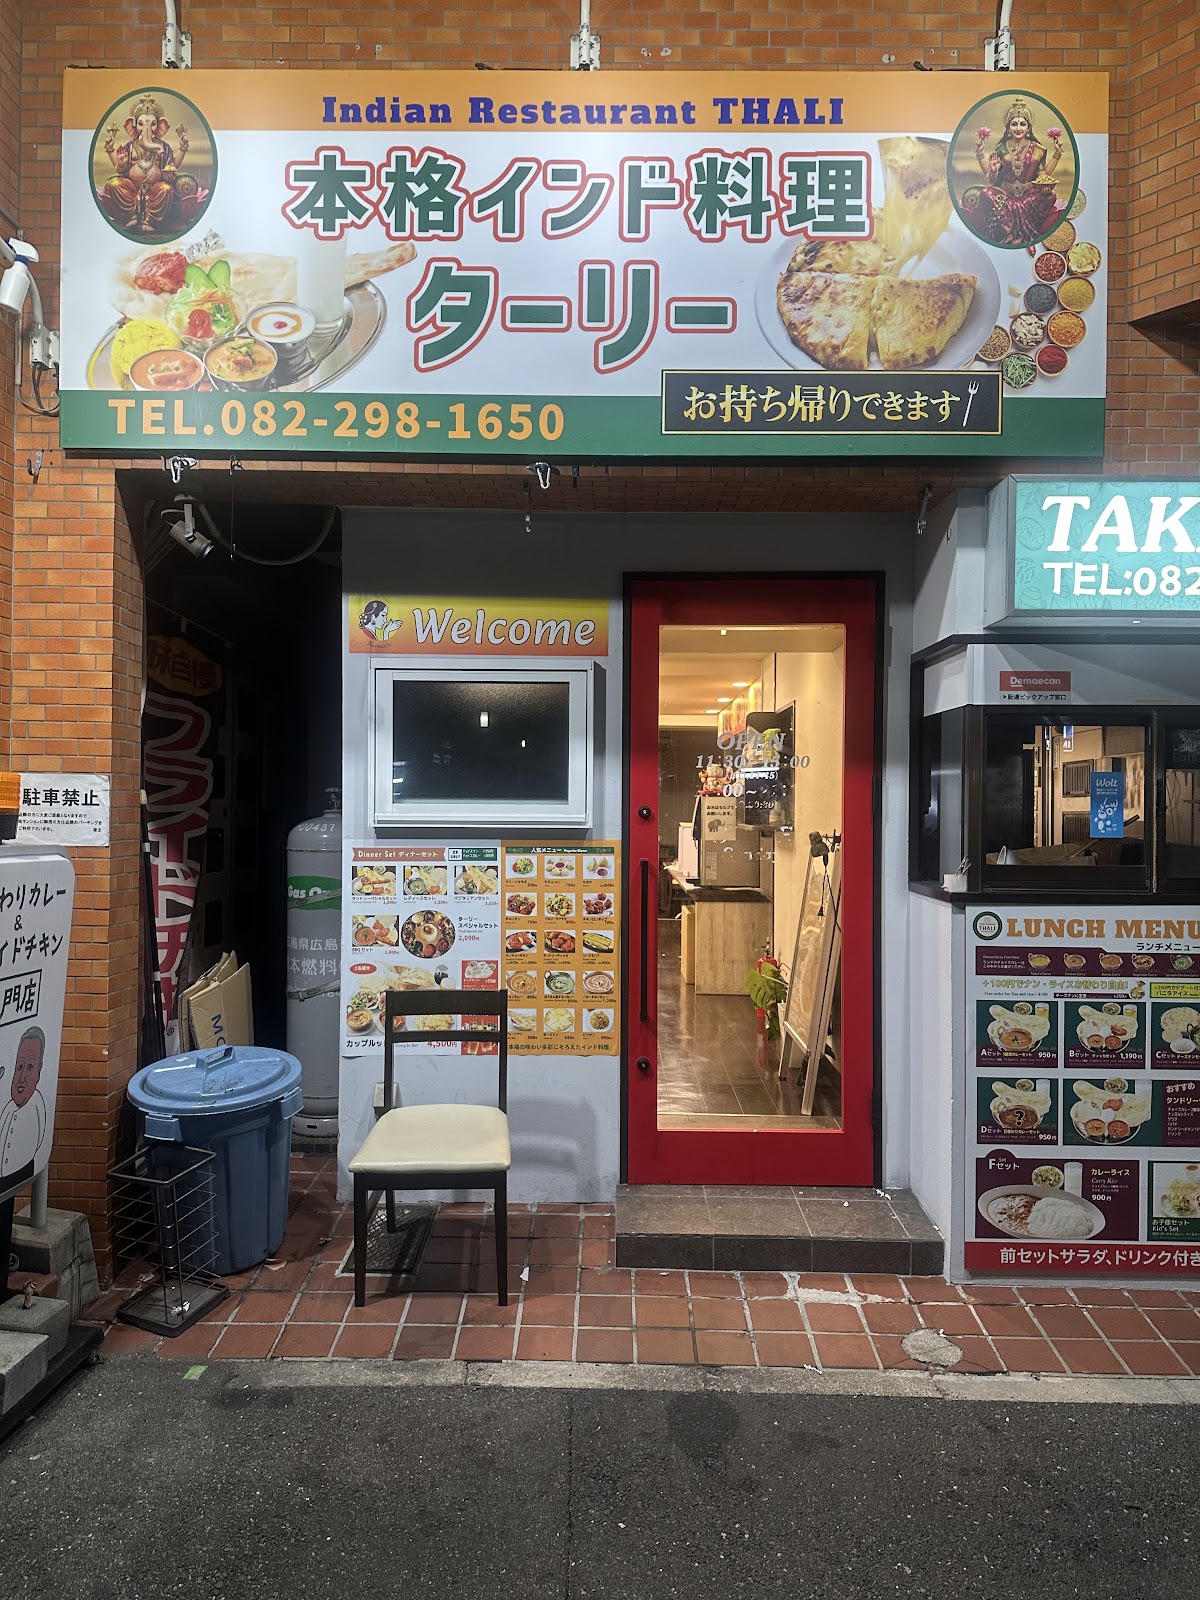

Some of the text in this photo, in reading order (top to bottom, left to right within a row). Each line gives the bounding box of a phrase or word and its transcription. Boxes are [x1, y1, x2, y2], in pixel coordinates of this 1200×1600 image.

[322, 96, 845, 125] Indian Restaurant THALI
[282, 146, 874, 243] 本格インド料理
[407, 257, 737, 374] ターリー
[683, 384, 961, 424] お持ち帰りできます
[108, 397, 565, 441] TEL.082-298-1650
[1042, 494, 1200, 553] TAK
[412, 608, 596, 646] Welcome
[1010, 676, 1061, 687] Demaecan
[716, 732, 787, 750] OPEN
[1095, 778, 1119, 787] Wolt
[22, 788, 100, 807] 駐車禁止
[358, 850, 382, 858] Dinner
[384, 850, 396, 858] Set
[287, 884, 307, 899] Gas
[14, 914, 23, 931] &
[1006, 918, 1200, 939] LUNCH MENU
[1136, 942, 1200, 951] ランチメニュー
[288, 956, 338, 976] 本燃料
[0, 977, 37, 1020] 門店
[346, 1039, 386, 1048] カップルッ
[1166, 1082, 1196, 1094] おすすめ
[1166, 1096, 1200, 1105] タンドリー
[1038, 1133, 1057, 1141] 950円
[988, 1158, 1020, 1170] Fセット
[1091, 1168, 1131, 1176] カレーライス
[1152, 1218, 1190, 1226] お子様セット
